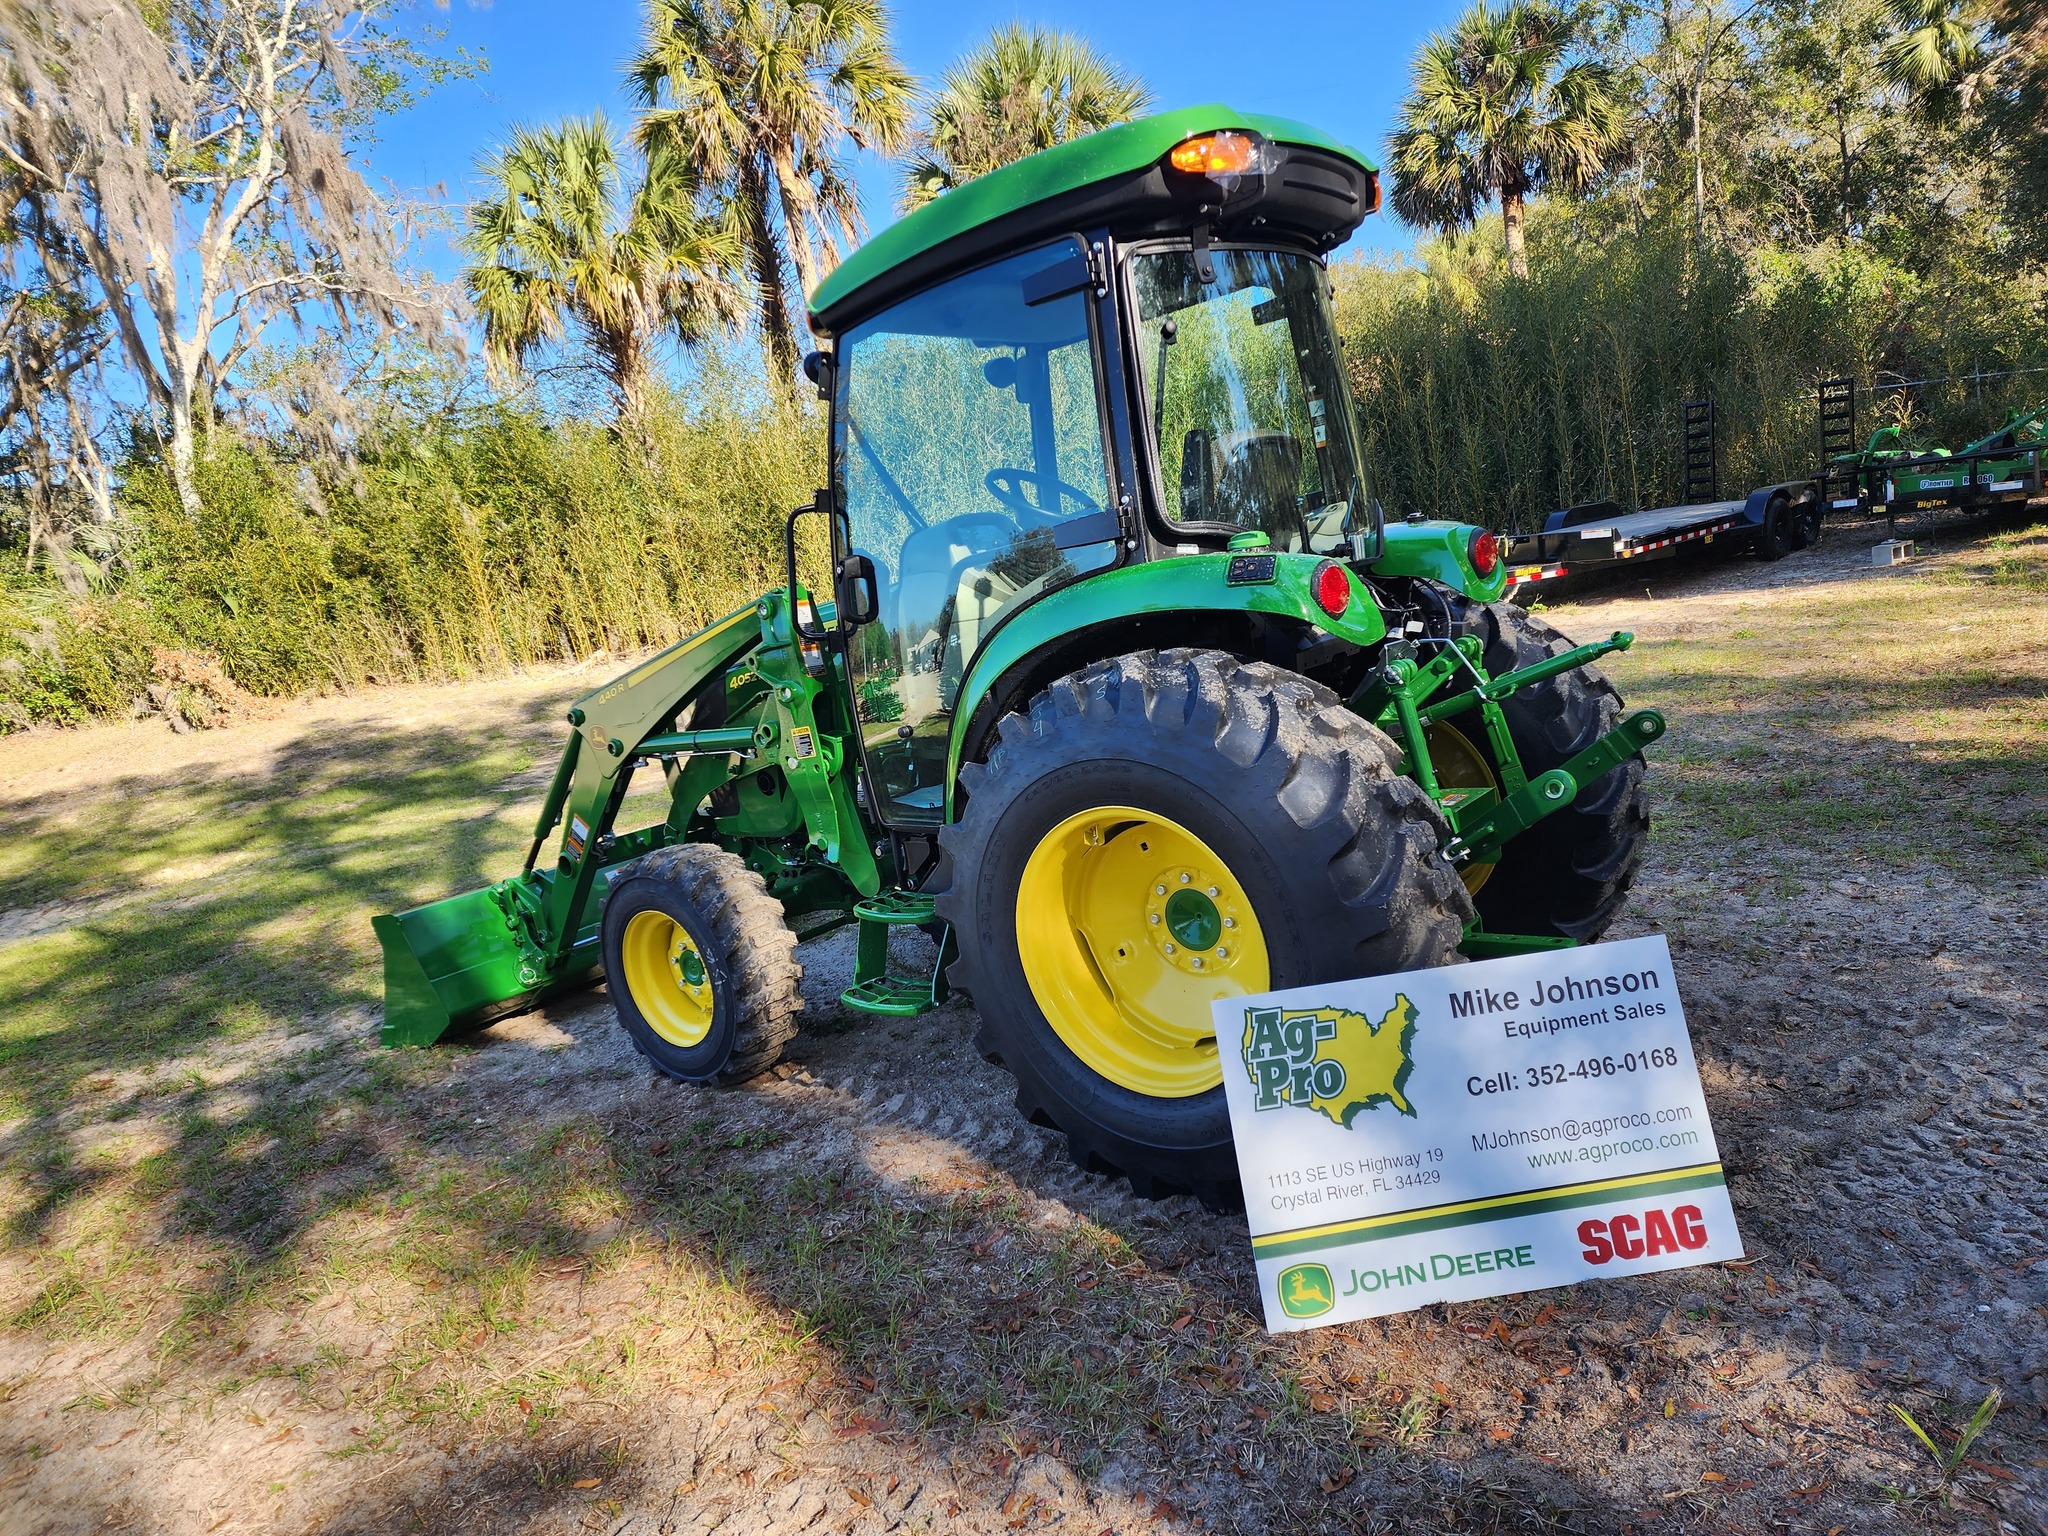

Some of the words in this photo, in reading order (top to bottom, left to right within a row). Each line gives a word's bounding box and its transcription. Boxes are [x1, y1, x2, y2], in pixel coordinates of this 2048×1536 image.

[730, 671, 761, 689] 4052
[1449, 988, 1519, 1019] Mike
[1530, 970, 1659, 1007] Johnson
[1247, 1006, 1337, 1065] Ag-
[1504, 1008, 1609, 1039] Equipment
[1614, 1002, 1666, 1022] Sales
[1253, 1056, 1346, 1112] Pro
[1467, 1071, 1519, 1096] Cell:
[1526, 1047, 1678, 1088] 352-496-0168
[1472, 1106, 1693, 1152] MJohnson@agproco.com
[1527, 1130, 1699, 1169] www.agproco.com
[1268, 1171, 1302, 1189] 1113
[1306, 1166, 1328, 1183] SE
[1331, 1161, 1355, 1179] US
[1359, 1152, 1421, 1174] Highway
[1426, 1148, 1444, 1163] 19
[1271, 1188, 1322, 1211] Crystal
[1327, 1182, 1369, 1201] River,
[1372, 1178, 1393, 1193] FL
[1395, 1170, 1441, 1190] 34429
[1577, 1204, 1709, 1266] SCAG
[1430, 1244, 1536, 1281] DEERE
